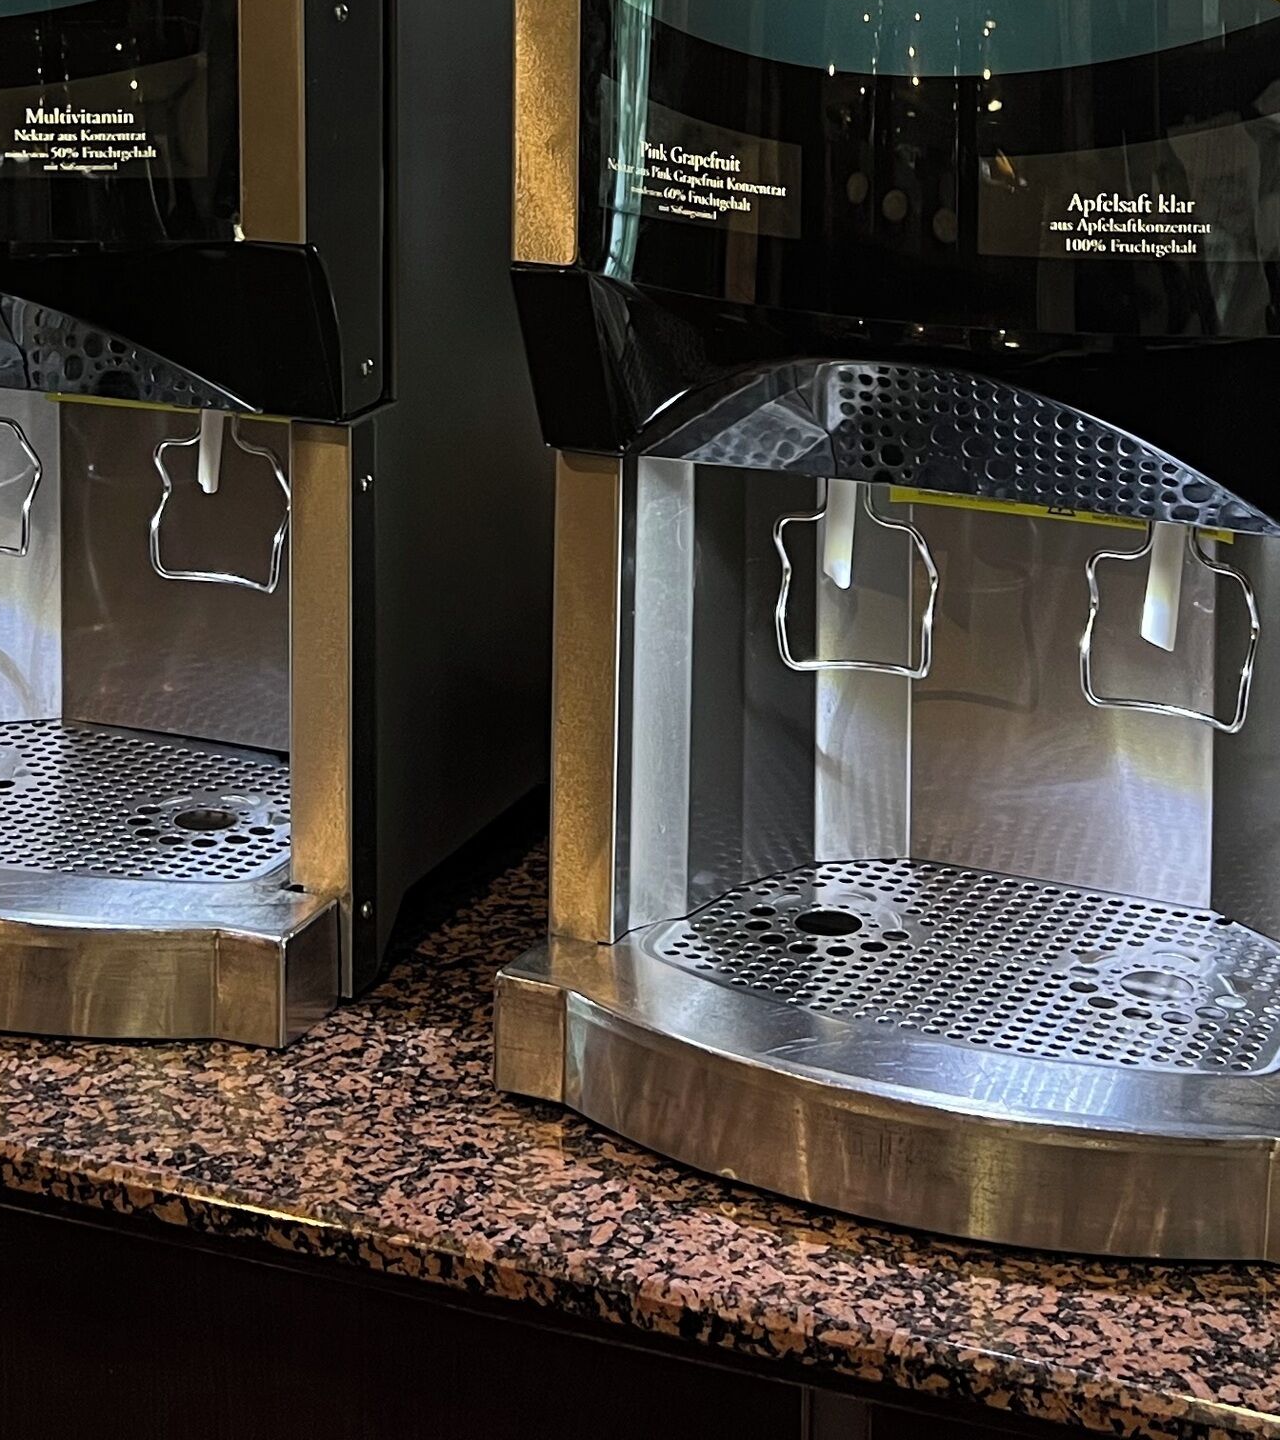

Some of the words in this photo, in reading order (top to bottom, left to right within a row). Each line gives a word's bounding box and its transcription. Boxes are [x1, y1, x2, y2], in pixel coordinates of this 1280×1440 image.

[25, 107, 134, 125] Multivitamin
[13, 129, 56, 142] Nektar
[57, 131, 78, 142] aus
[80, 129, 147, 142] Konzentrat
[50, 146, 80, 159] 50%
[81, 145, 157, 162] Fruchtgehalt
[639, 139, 668, 162] Pink
[670, 145, 742, 172] Grapefruit
[651, 165, 672, 182] Pink
[673, 169, 725, 189] Grapefruit
[726, 177, 787, 197] Konzentrat
[688, 190, 752, 212] Fruchtgehalt
[1067, 192, 1153, 217] Apfelsaft
[1158, 193, 1197, 214] klar
[1049, 220, 1074, 232] aus
[1076, 217, 1212, 236] Apfelsaftkonzentrat
[1065, 237, 1107, 253] 100%
[1110, 238, 1197, 258] Fruchtgehalt
